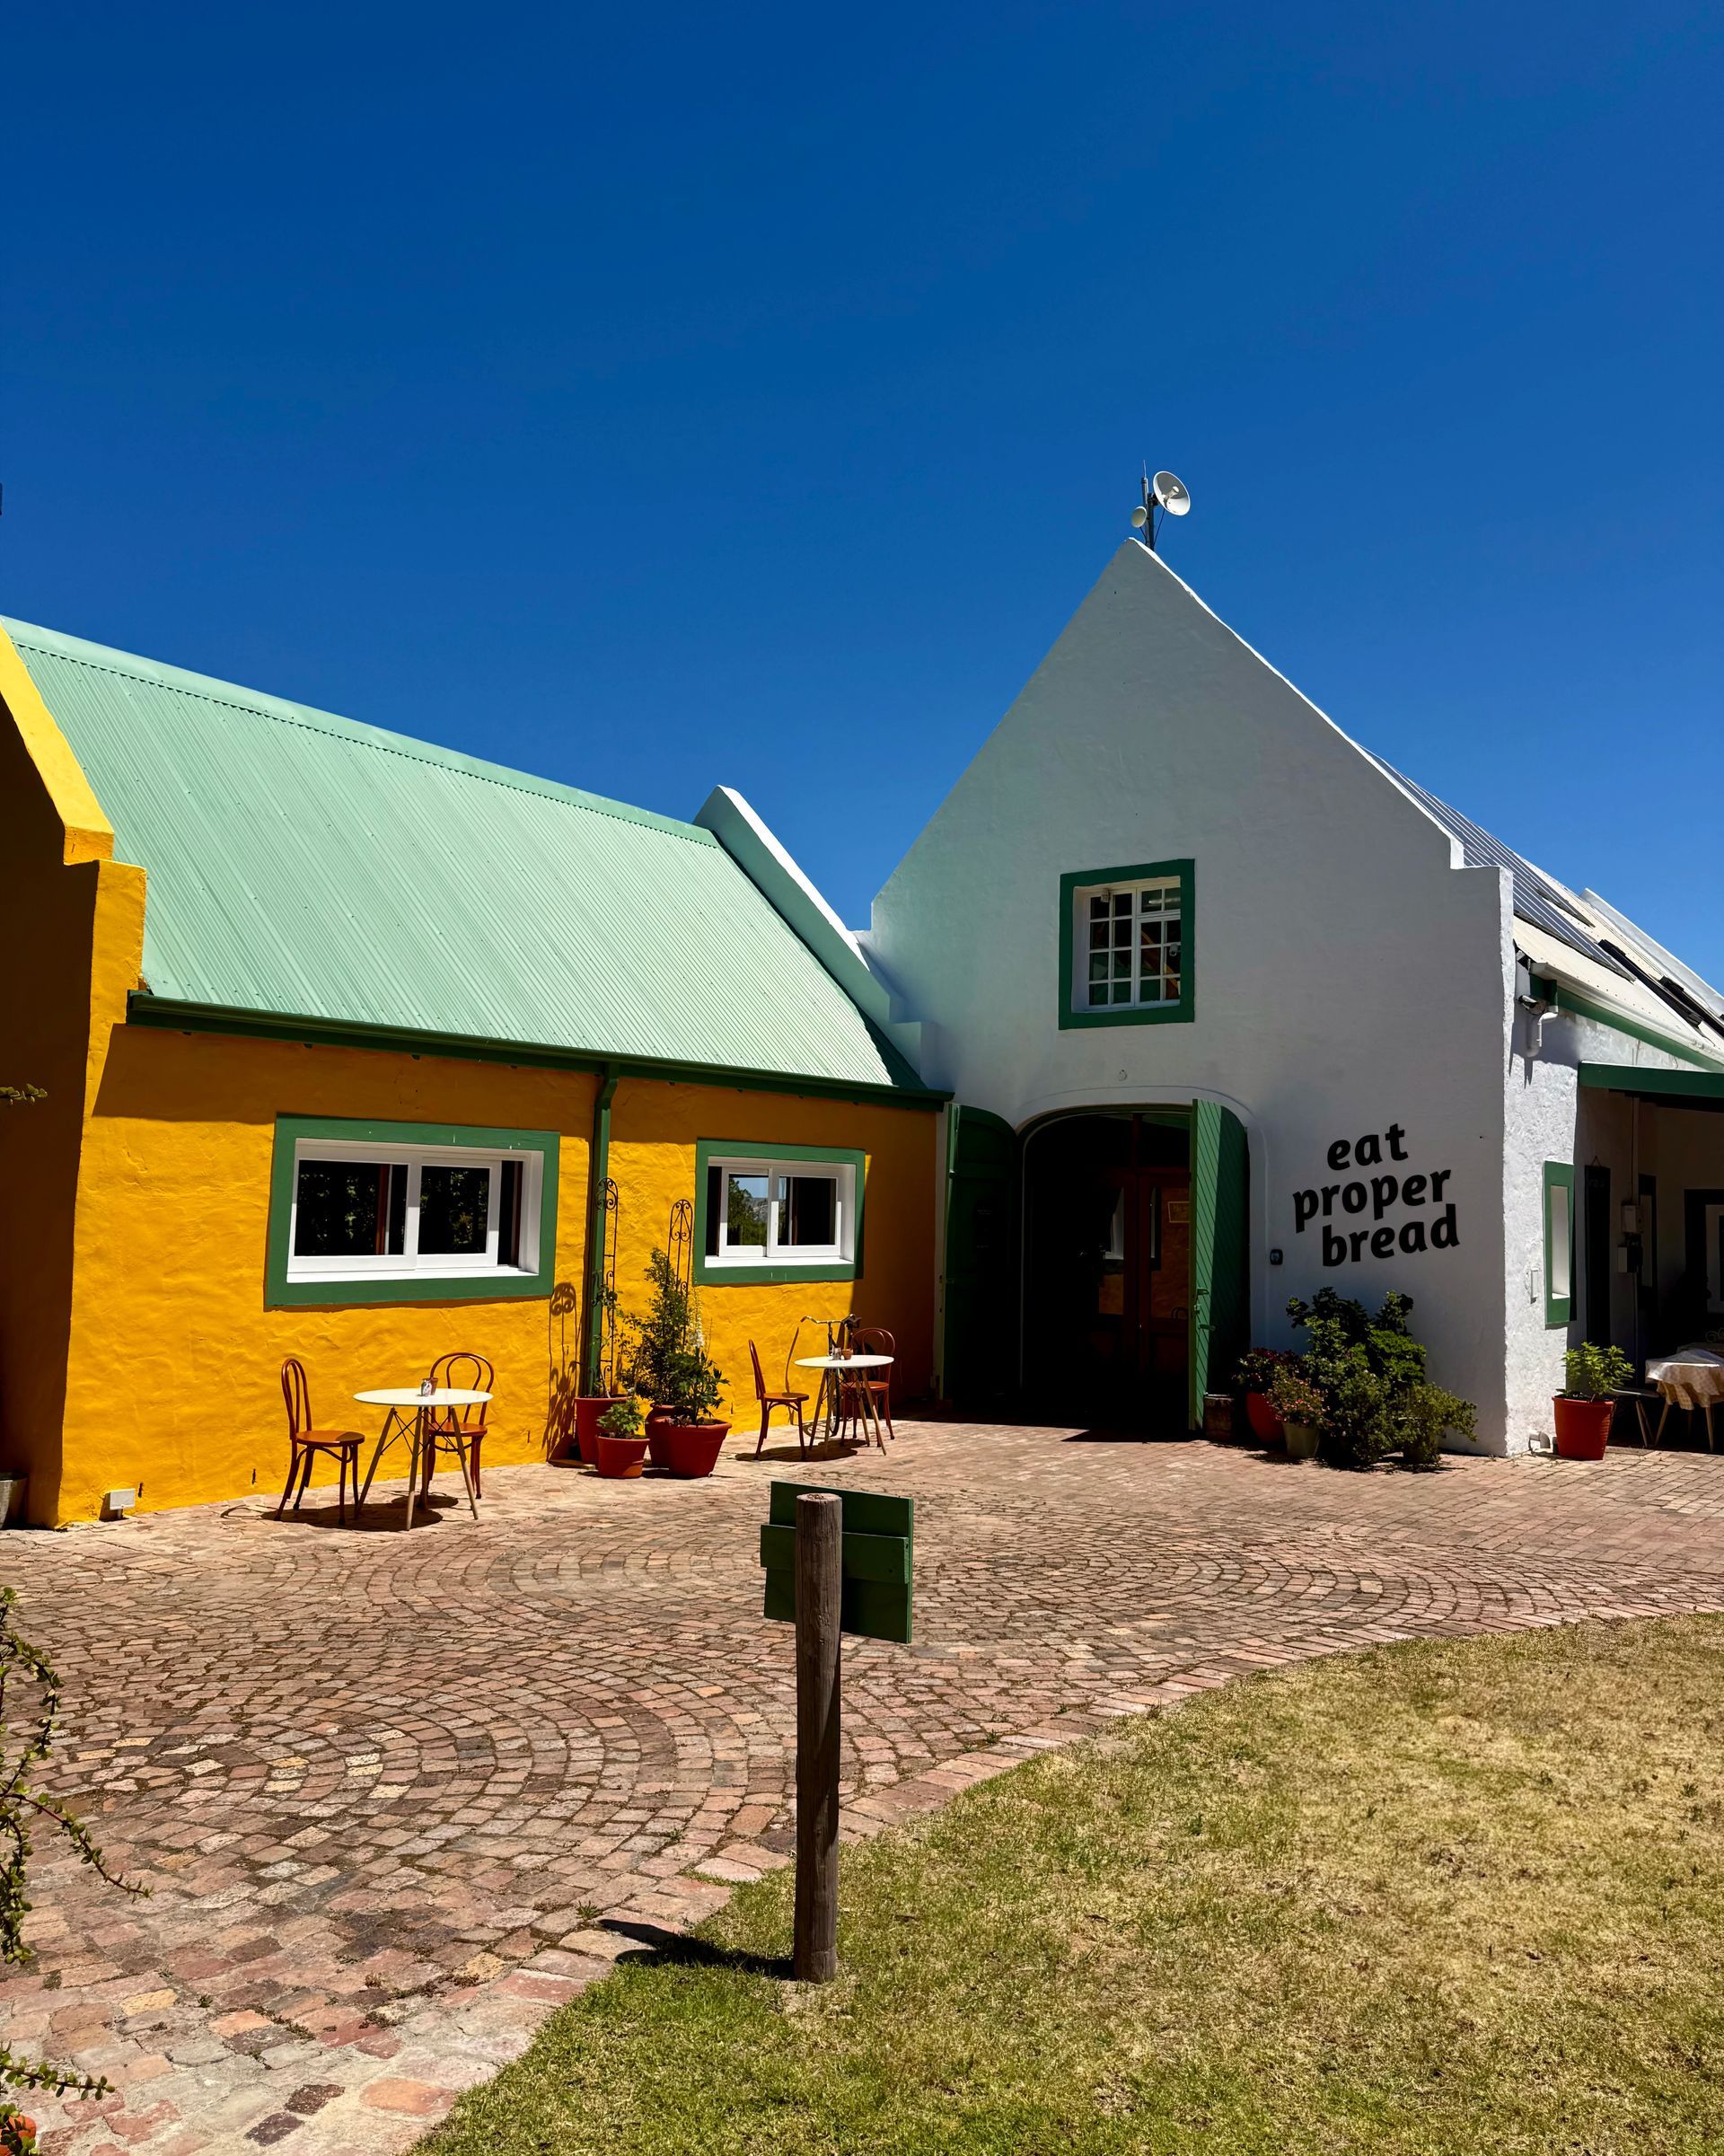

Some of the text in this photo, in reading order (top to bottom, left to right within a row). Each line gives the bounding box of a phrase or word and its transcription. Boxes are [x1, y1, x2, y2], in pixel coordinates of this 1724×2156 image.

[1327, 1123, 1409, 1171] eat
[1292, 1169, 1452, 1234] proper
[1322, 1203, 1460, 1267] bread
